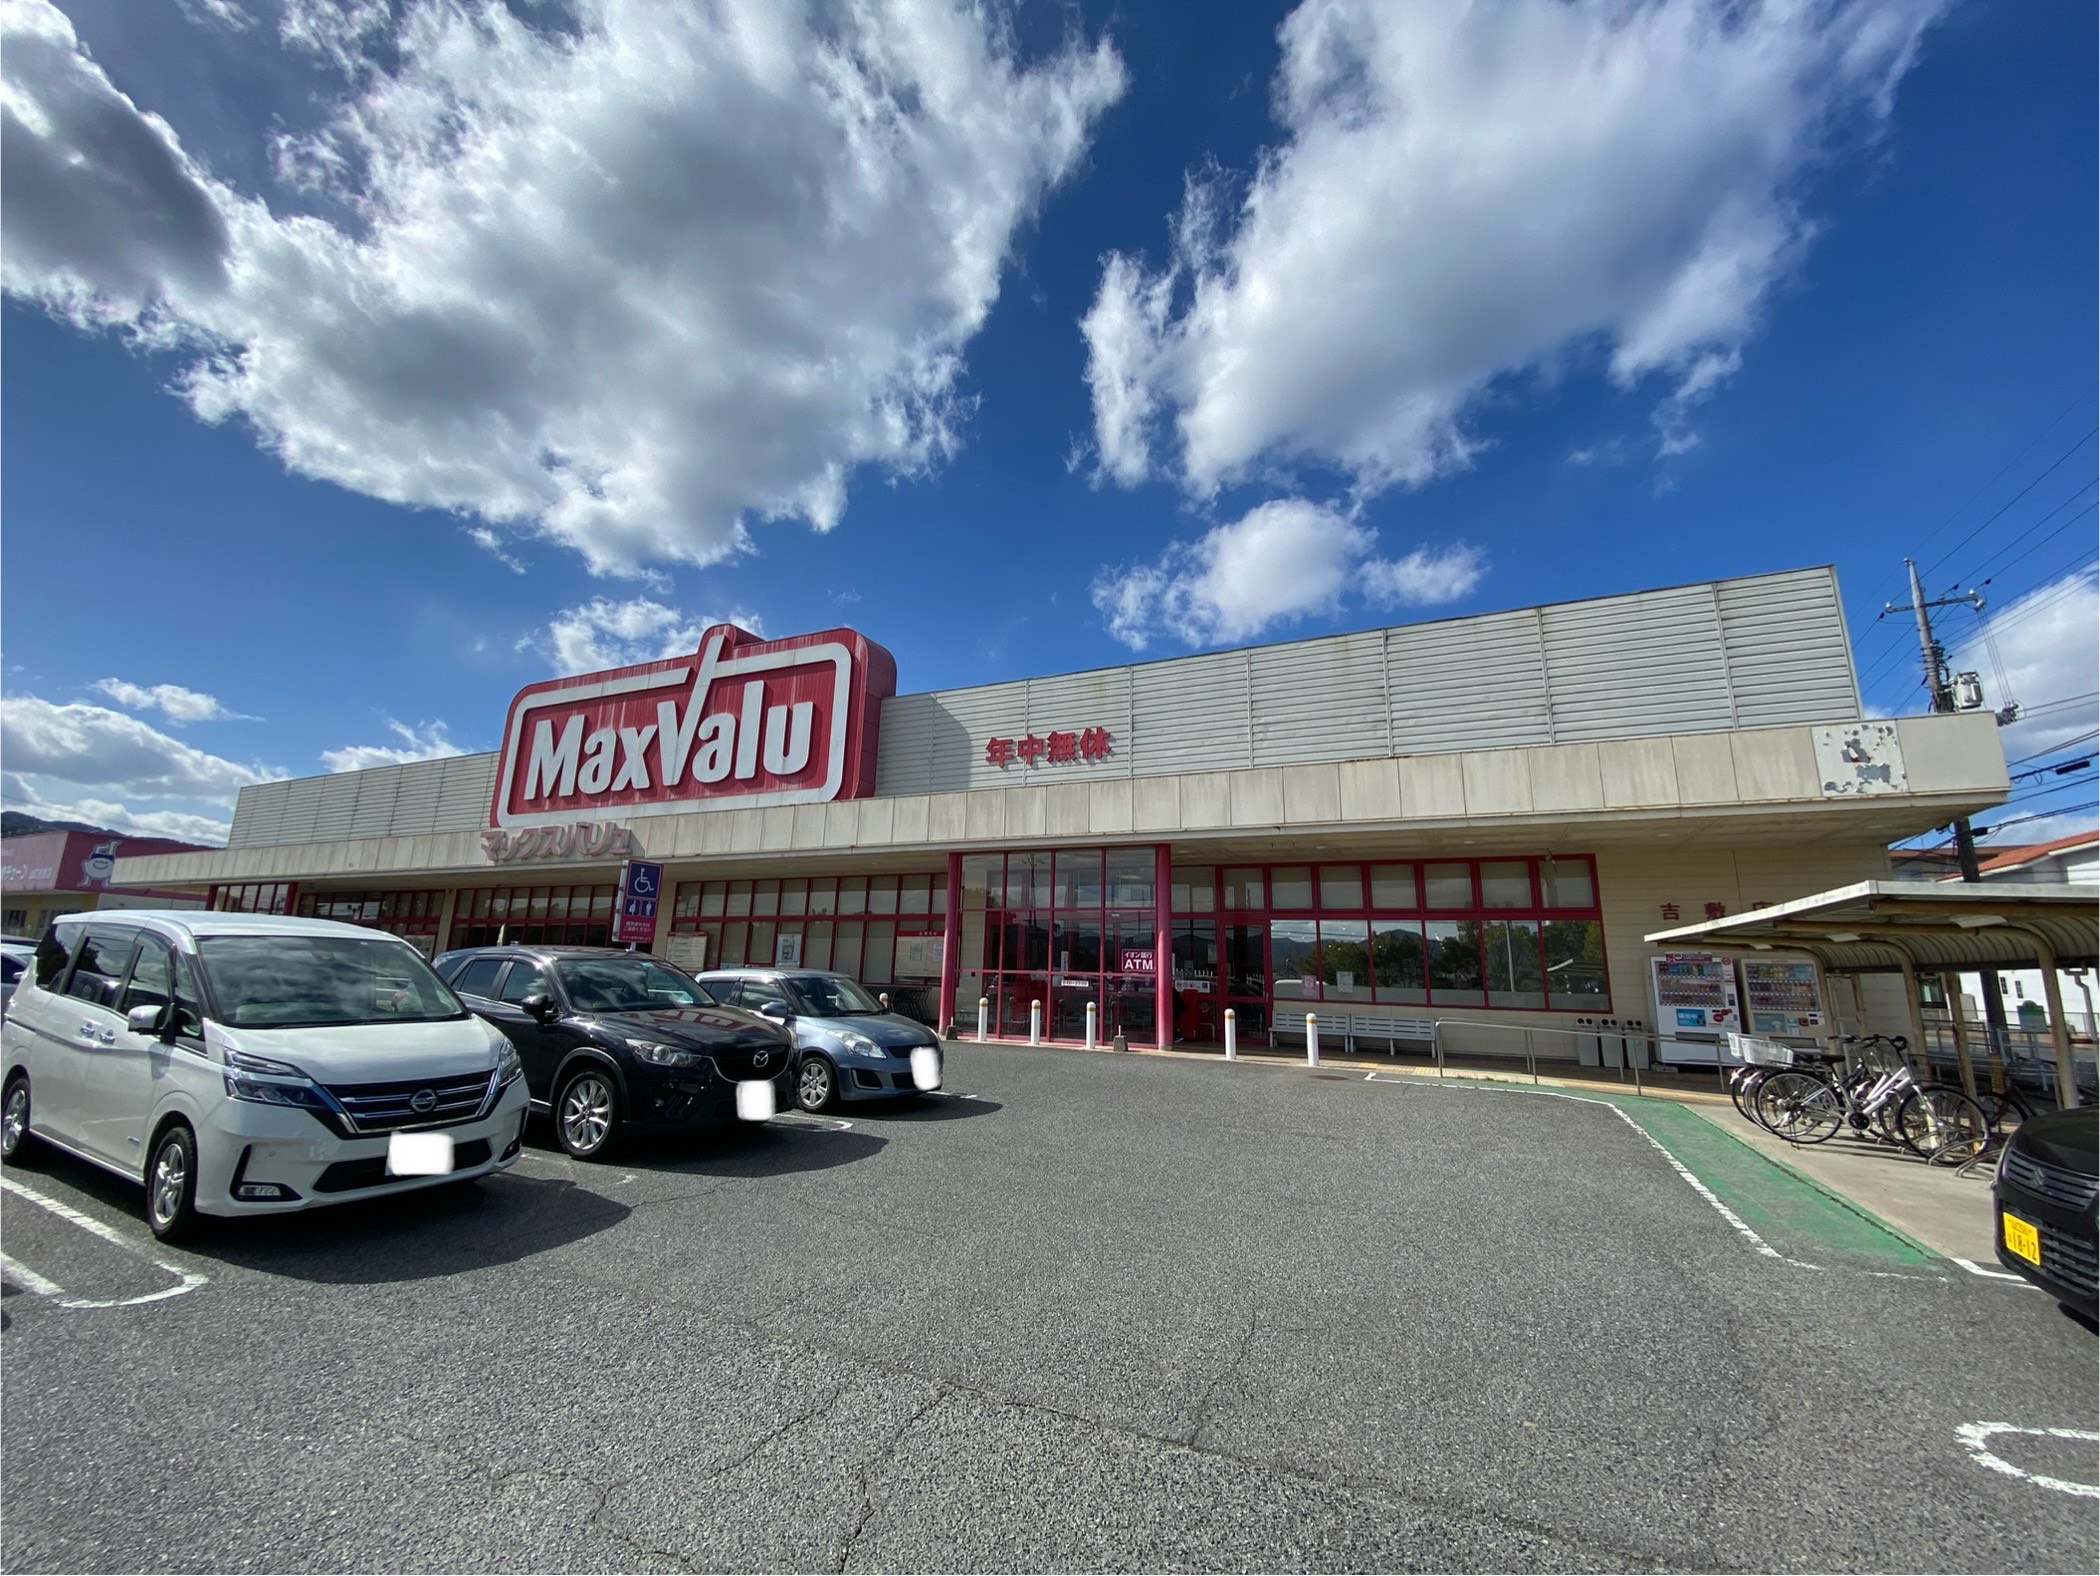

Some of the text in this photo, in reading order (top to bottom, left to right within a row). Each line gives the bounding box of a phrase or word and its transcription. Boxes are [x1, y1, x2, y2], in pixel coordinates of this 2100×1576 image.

[524, 636, 813, 800] MaxValu
[985, 726, 1111, 768] 年中無休
[480, 821, 632, 862] マックスバリュ
[1124, 951, 1153, 959] イオン銀行
[1124, 959, 1153, 970] ATM
